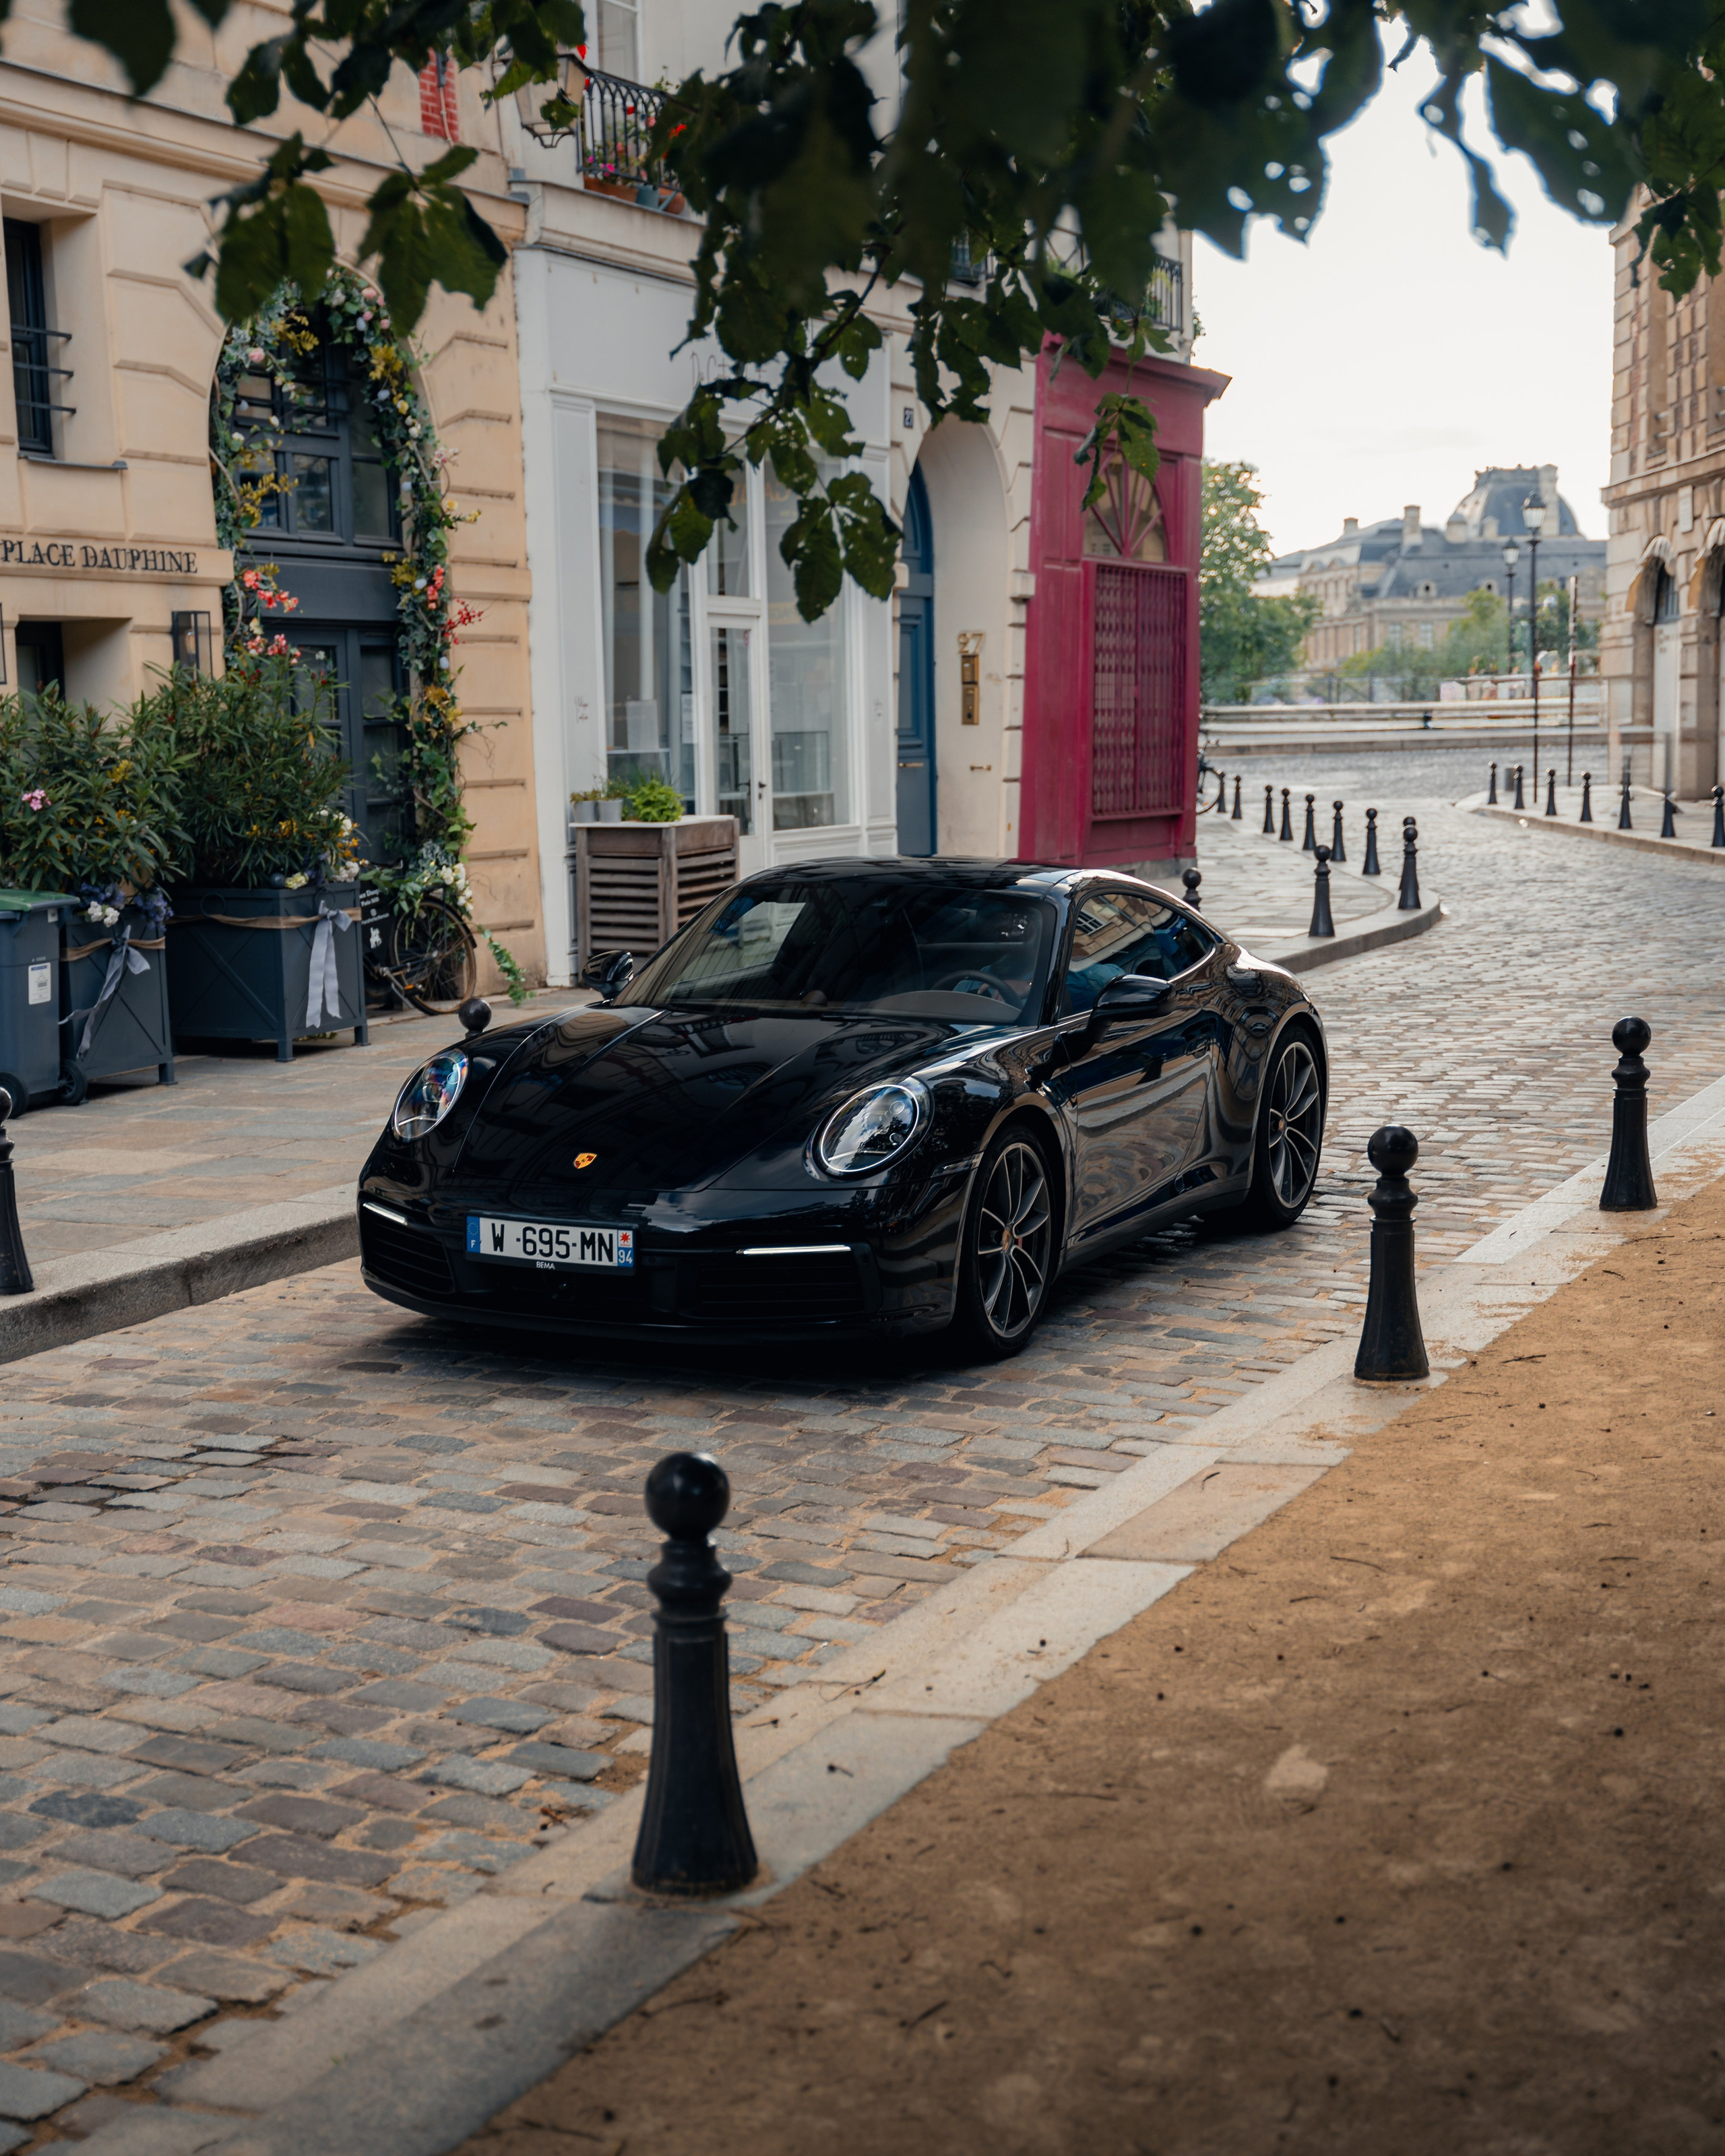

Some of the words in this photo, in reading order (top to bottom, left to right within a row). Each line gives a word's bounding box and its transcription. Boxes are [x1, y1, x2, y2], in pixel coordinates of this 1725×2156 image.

[1, 540, 75, 567] PLACE
[80, 544, 198, 573] DAUPHINE
[958, 631, 986, 655] 27
[471, 1240, 476, 1248] F
[618, 1249, 633, 1264] 94
[536, 1261, 555, 1269] BEMA
